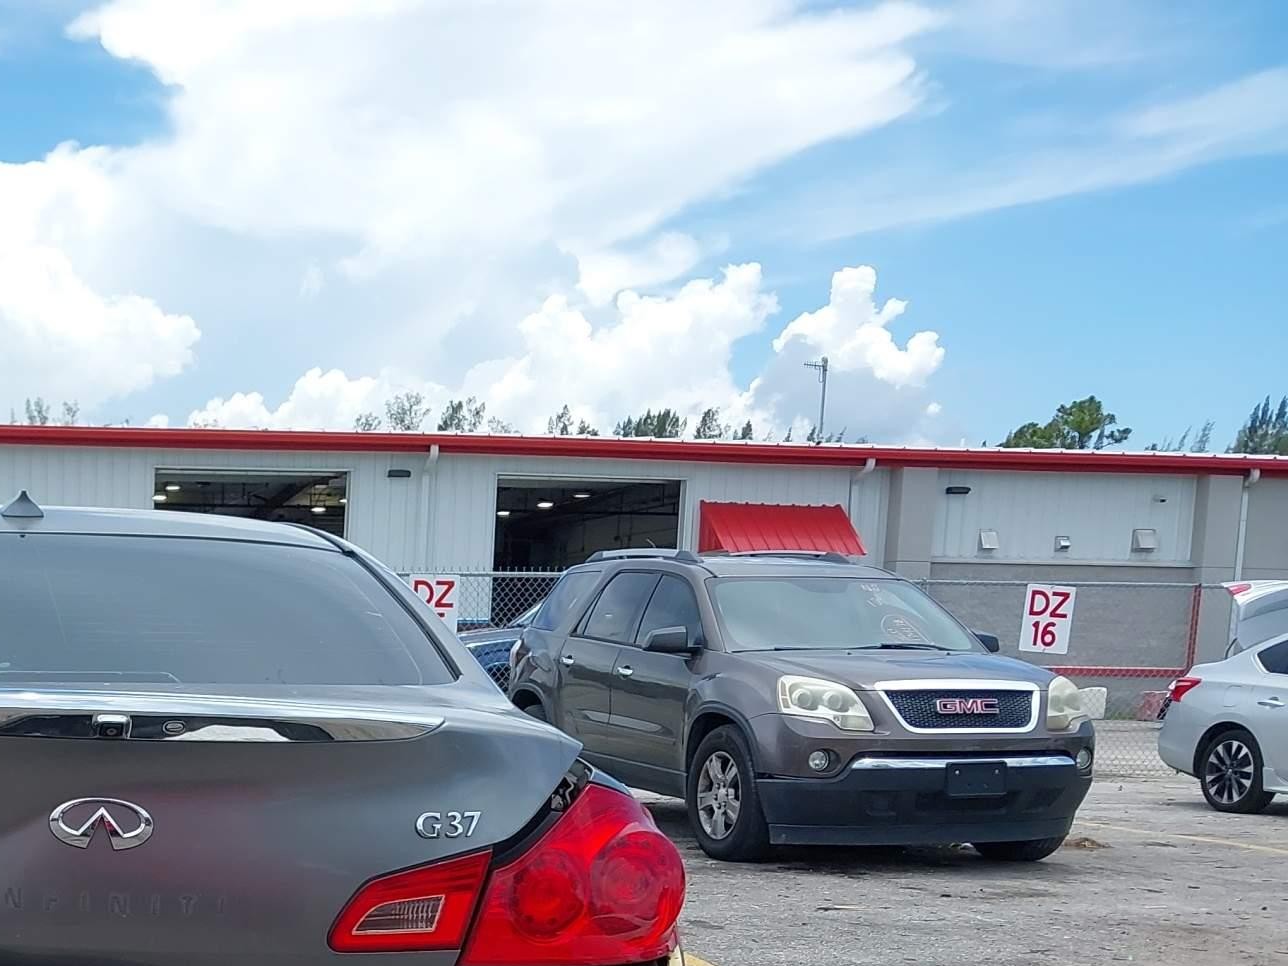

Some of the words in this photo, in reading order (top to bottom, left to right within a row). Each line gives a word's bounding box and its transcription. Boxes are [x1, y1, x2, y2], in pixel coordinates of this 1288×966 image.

[413, 579, 455, 608] DZ
[1028, 589, 1071, 619] DZ
[1031, 620, 1056, 647] 16
[936, 698, 1000, 714] GMC
[415, 811, 482, 839] G37
